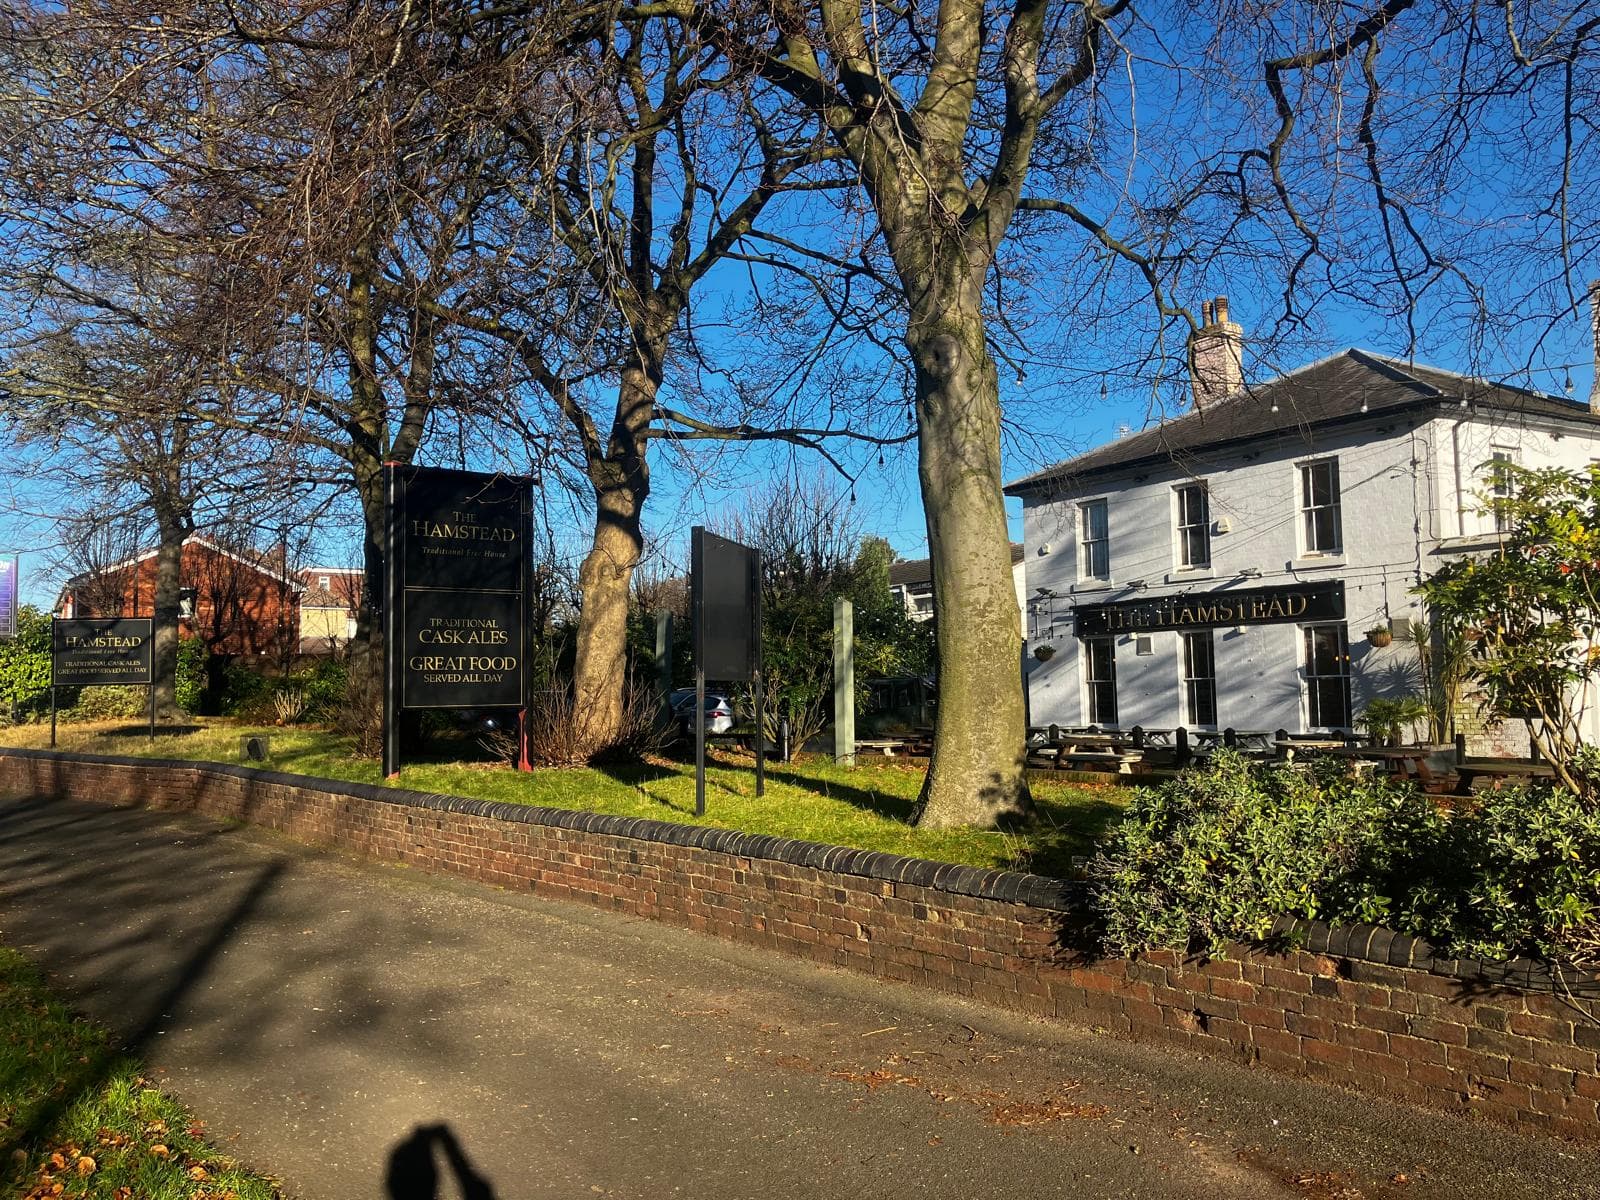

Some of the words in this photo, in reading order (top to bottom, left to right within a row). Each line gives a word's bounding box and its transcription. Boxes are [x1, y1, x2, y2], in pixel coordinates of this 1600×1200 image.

[452, 511, 477, 523] THE
[412, 520, 515, 542] HAMSTEAD
[422, 546, 464, 556] Traditional
[483, 550, 507, 558] House
[1100, 605, 1150, 629] THE
[1155, 592, 1307, 626] HAMSTEAD
[429, 618, 498, 628] TRADITIONAL
[95, 628, 113, 636] THE
[418, 629, 465, 644] CASK
[467, 630, 509, 644] ALES
[65, 636, 142, 647] HAMSTEAD
[409, 656, 466, 671] GREAT
[469, 656, 517, 671] FOOD
[423, 673, 461, 683] SERVED
[462, 673, 481, 682] ALL
[483, 673, 504, 682] DAY
